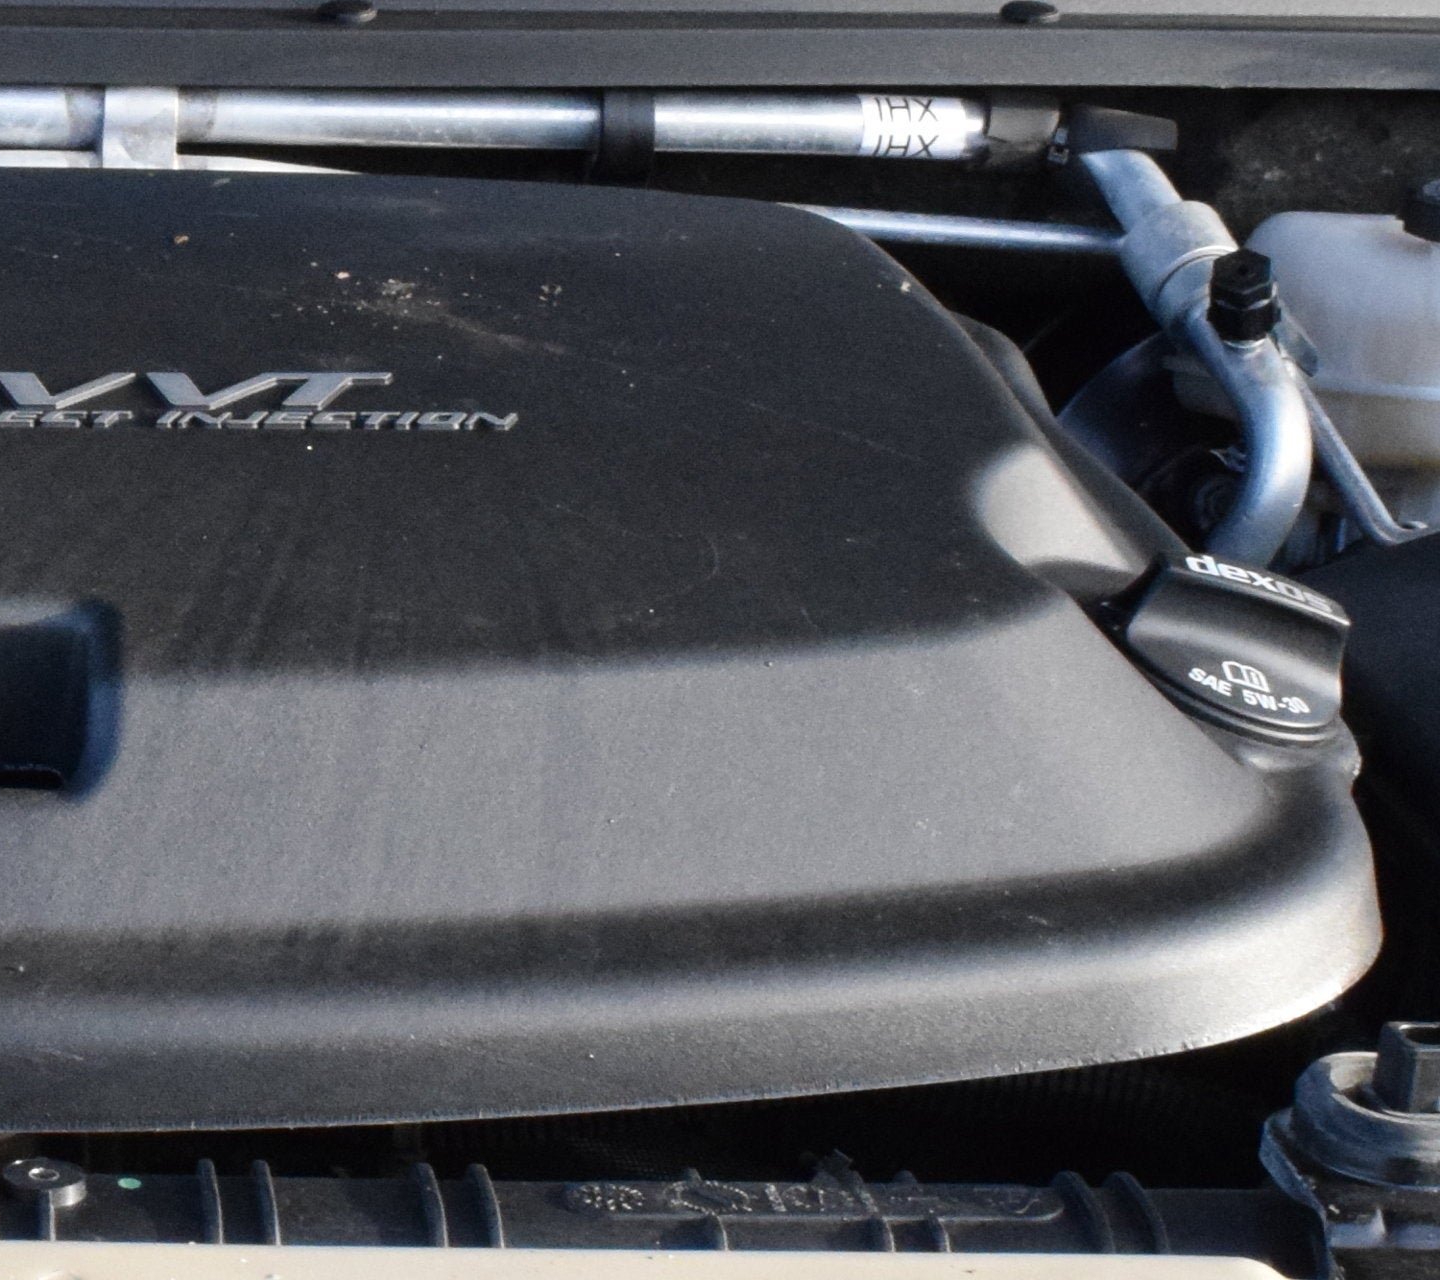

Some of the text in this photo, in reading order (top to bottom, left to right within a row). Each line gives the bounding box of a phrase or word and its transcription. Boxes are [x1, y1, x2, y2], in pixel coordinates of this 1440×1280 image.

[874, 97, 938, 122] IHX
[155, 410, 519, 431] INJECTION
[1185, 554, 1334, 615] dexos
[1188, 667, 1310, 715] SAE 5W-30
